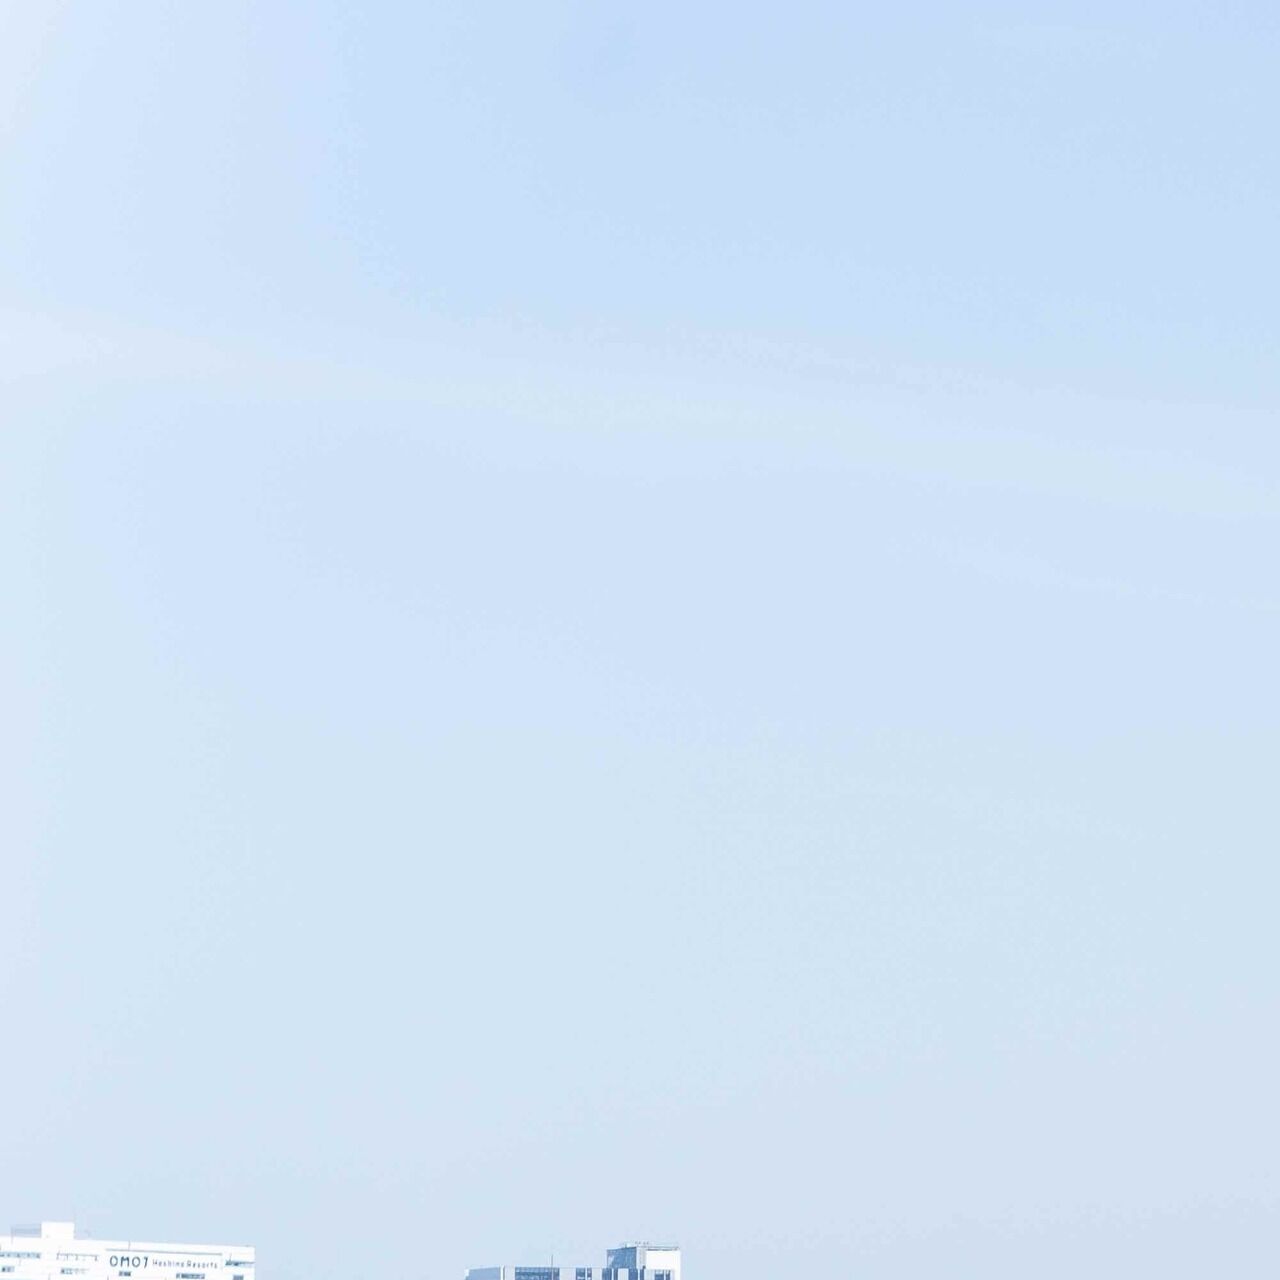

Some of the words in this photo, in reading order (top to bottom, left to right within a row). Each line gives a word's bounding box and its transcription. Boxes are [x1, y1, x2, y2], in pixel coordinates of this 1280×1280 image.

[109, 1254, 149, 1269] OMO7
[152, 1258, 184, 1268] Hoshino
[187, 1259, 218, 1270] Resorts
